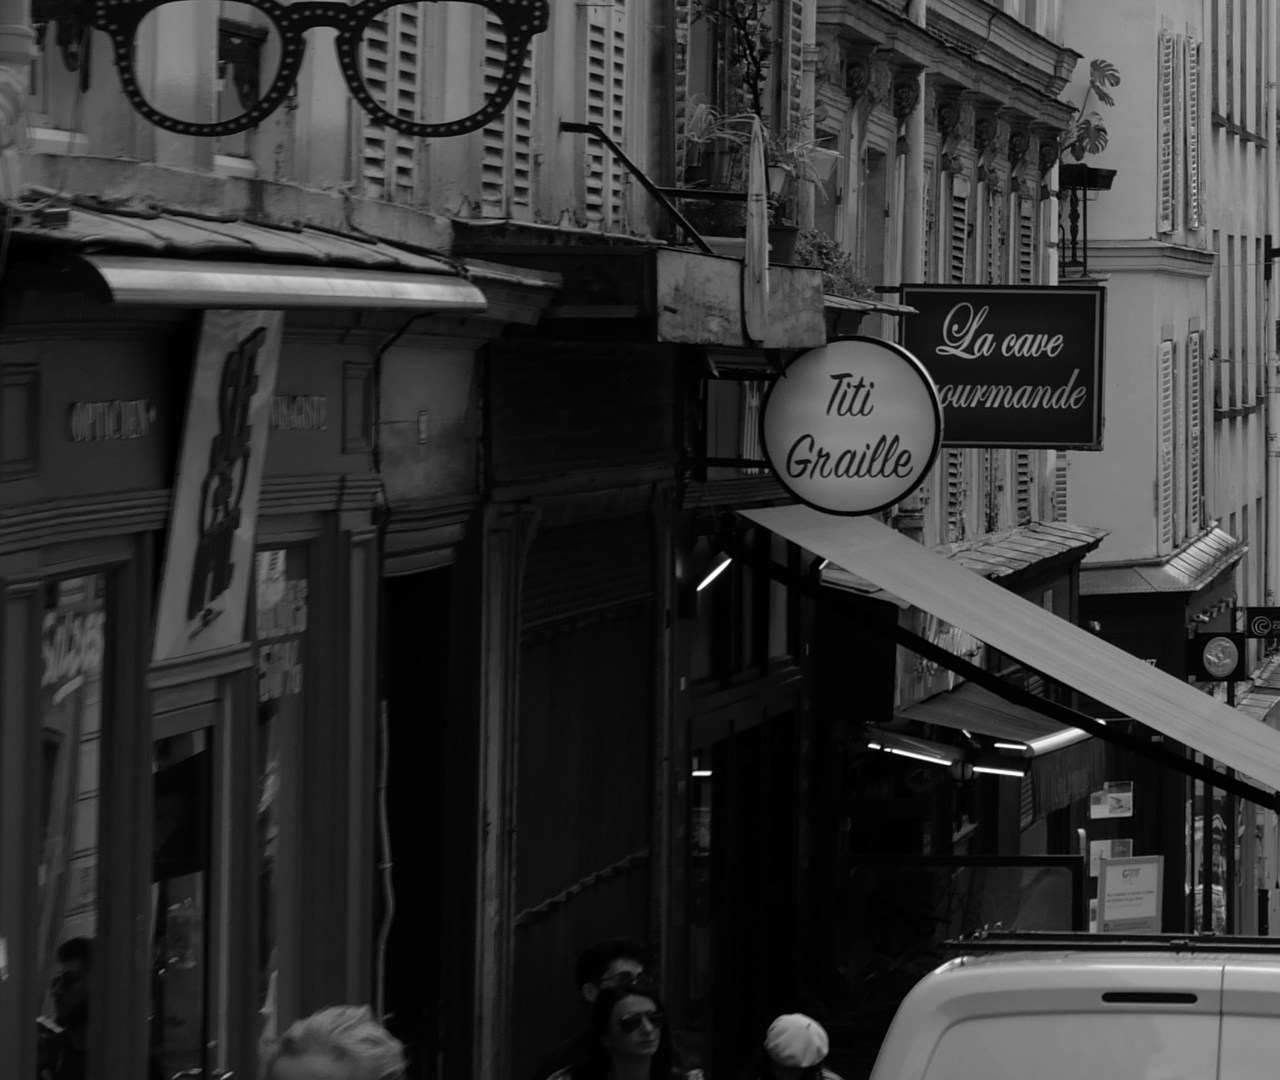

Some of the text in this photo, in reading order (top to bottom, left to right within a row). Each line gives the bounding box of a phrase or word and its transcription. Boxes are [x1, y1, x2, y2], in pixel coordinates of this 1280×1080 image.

[936, 302, 1064, 361] La cave
[825, 372, 875, 418] Titi
[936, 369, 1086, 410] ourmande
[786, 434, 914, 481] Graille
